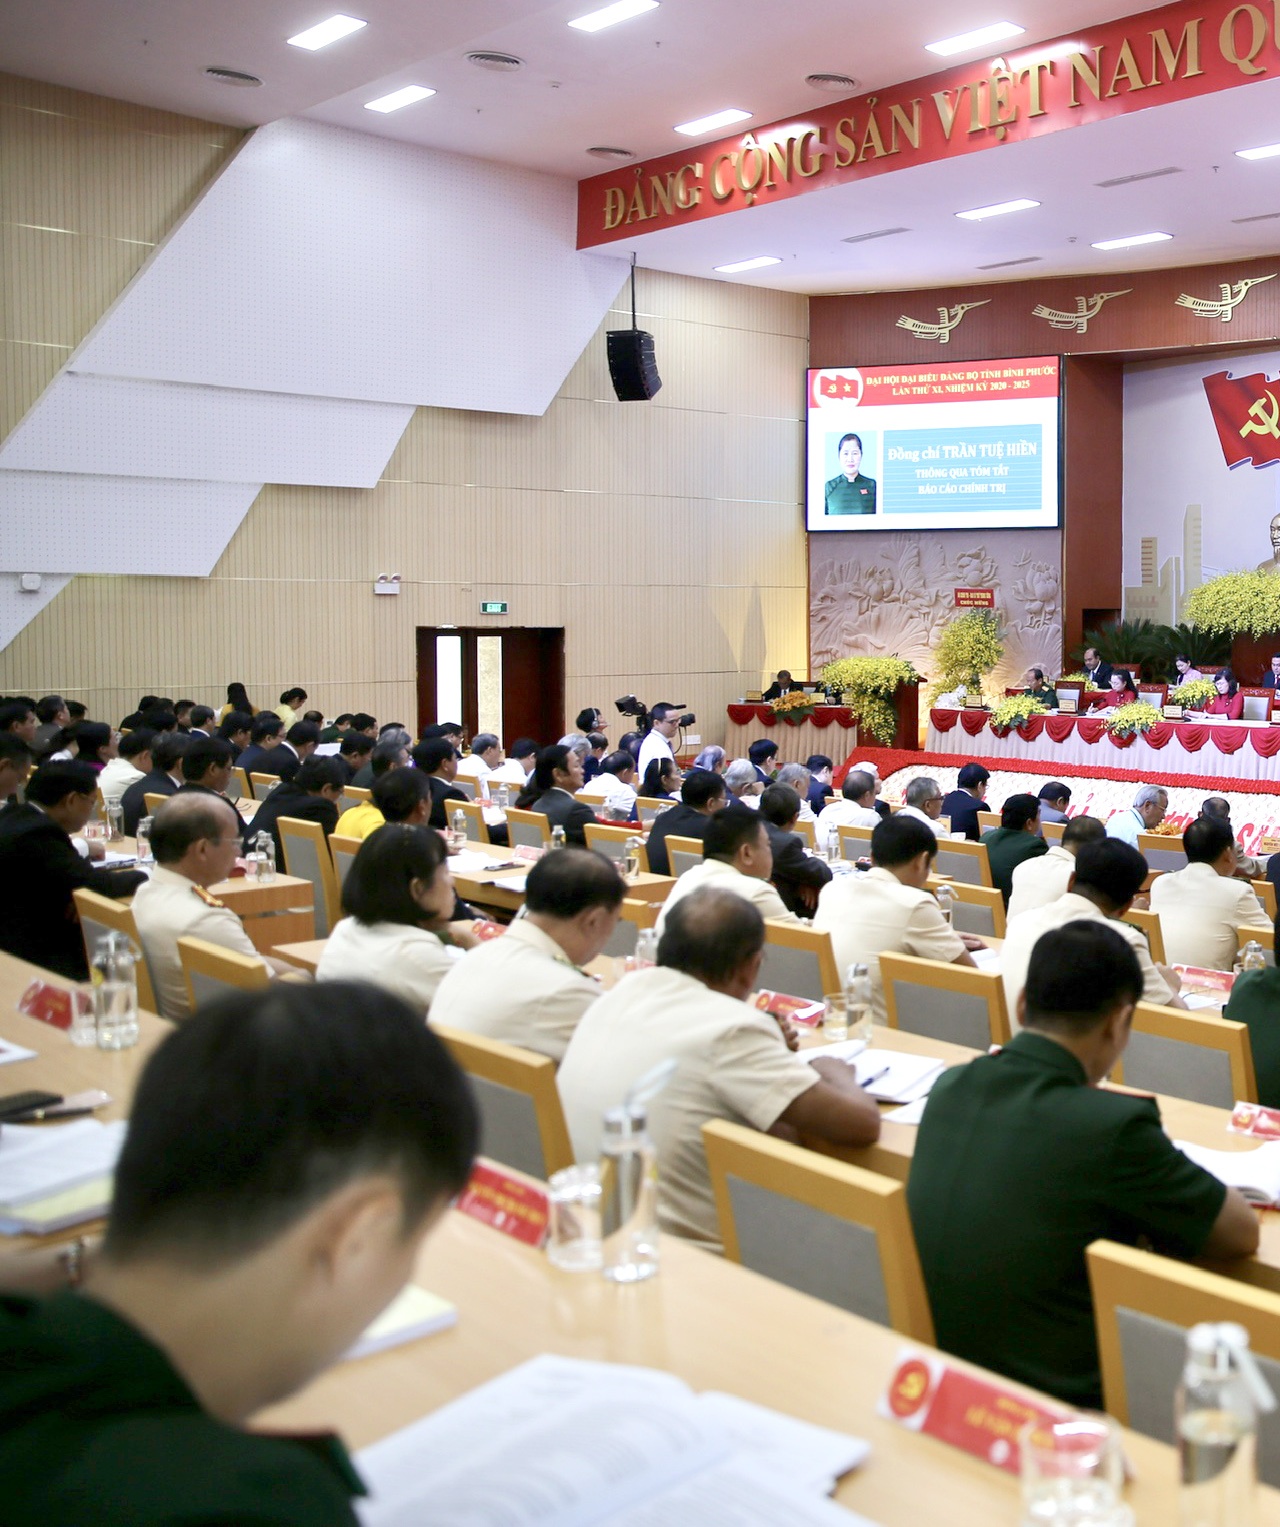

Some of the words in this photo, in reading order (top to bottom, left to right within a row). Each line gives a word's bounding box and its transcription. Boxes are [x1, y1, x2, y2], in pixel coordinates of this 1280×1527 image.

[603, 163, 703, 230] ĐẢNG
[710, 128, 826, 205] CỘNG
[834, 98, 922, 168] SẢN
[932, 57, 1055, 139] VIỆT
[1067, 18, 1205, 108] NAM
[990, 381, 1007, 391] 2020
[1013, 380, 1030, 389] 2025
[888, 446, 920, 462] Đồng
[922, 445, 941, 459] chí
[942, 441, 976, 459] TRẦN
[979, 440, 1004, 459] TUỆ
[1007, 439, 1037, 456] HIỀN
[915, 467, 948, 479] THÔNG
[949, 467, 968, 479] QUA
[970, 466, 991, 477] TÓM
[918, 483, 937, 495] BÁO
[939, 482, 958, 494] CÁO
[959, 482, 988, 493] CHÍNH
